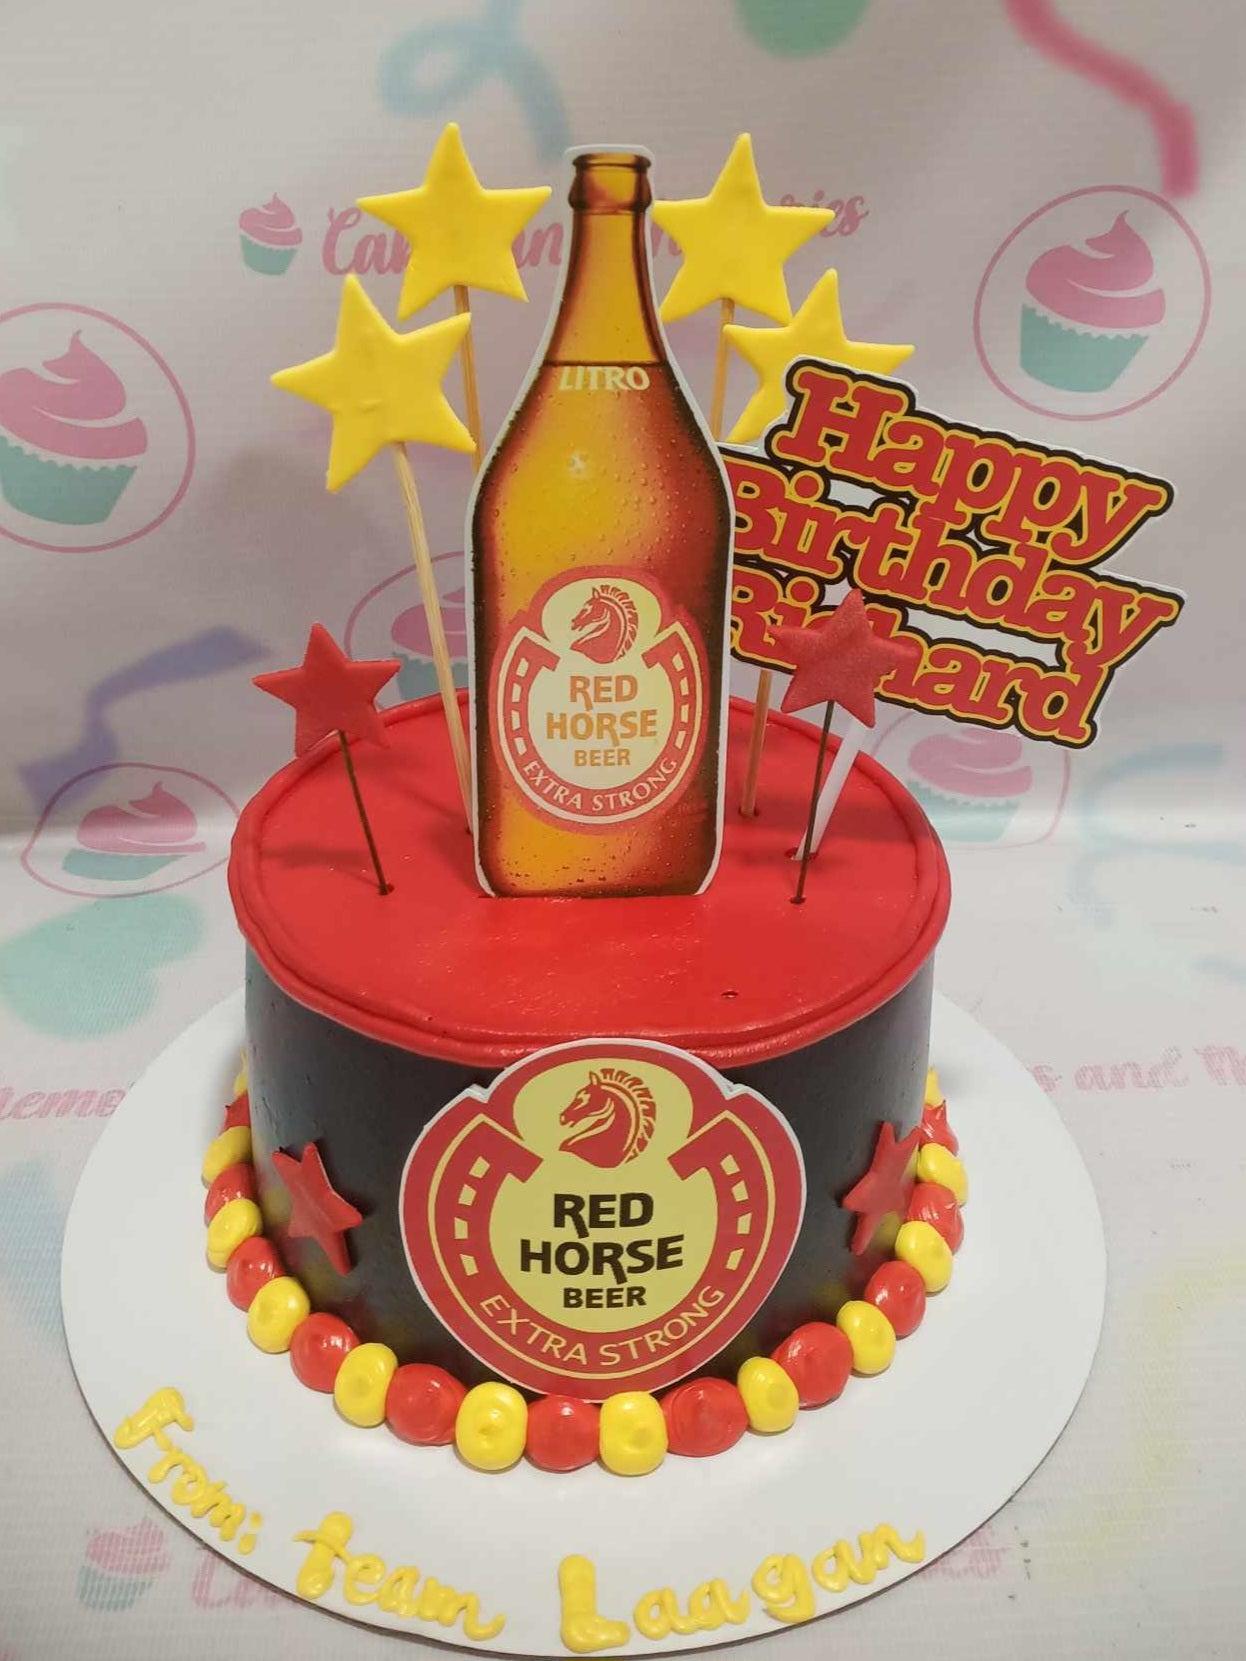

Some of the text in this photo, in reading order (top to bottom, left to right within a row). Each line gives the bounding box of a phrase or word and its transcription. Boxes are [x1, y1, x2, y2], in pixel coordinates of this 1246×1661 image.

[559, 365, 650, 391] LITRO
[771, 364, 1169, 566] Happy
[723, 458, 1181, 668] Birthday
[569, 674, 638, 711] RED
[546, 709, 658, 747] HORSE
[573, 749, 631, 767] BEER
[522, 756, 678, 812] EXTRA STRONG
[553, 1191, 654, 1239] RED
[519, 1234, 685, 1284] HORSE
[562, 1285, 647, 1309] BEER
[479, 1284, 725, 1367] EXTRA STRONG
[293, 1511, 506, 1641] team
[557, 1522, 925, 1653] Laagan
